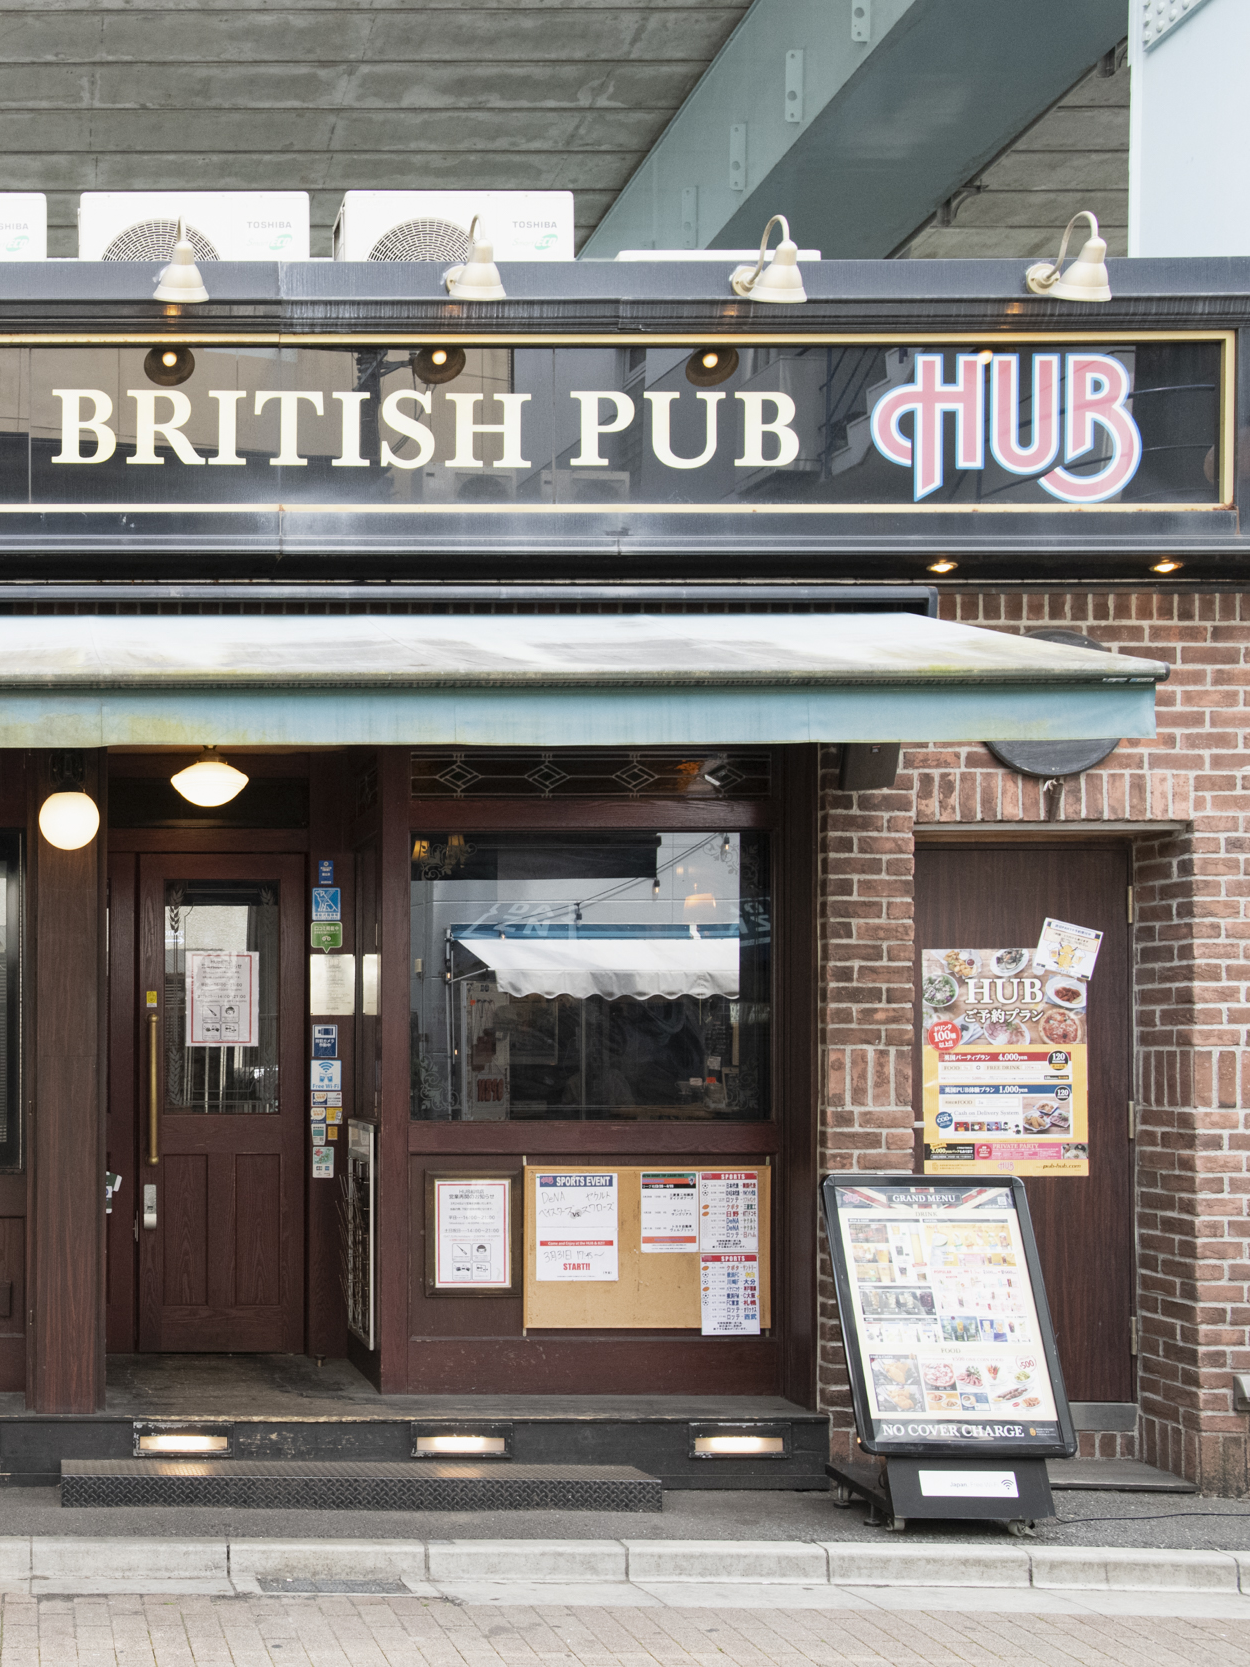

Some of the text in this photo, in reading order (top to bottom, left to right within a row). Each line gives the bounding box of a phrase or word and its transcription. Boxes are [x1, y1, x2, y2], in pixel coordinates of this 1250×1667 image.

[51, 388, 800, 469] BRITISH PUB
[870, 352, 1143, 503] HUB
[964, 978, 1044, 1004] HUB
[964, 1008, 1044, 1024] ご予約プラン
[997, 1162, 1015, 1172] HUB
[556, 1176, 585, 1186] SPORTS
[586, 1176, 610, 1186] EVENT
[541, 1191, 566, 1204] DeNA
[892, 1194, 956, 1203] GRAND MENU
[563, 1262, 591, 1271] START!!
[882, 1424, 905, 1436] NO
[906, 1424, 960, 1437] COVER
[961, 1425, 1025, 1438] CHARGE
